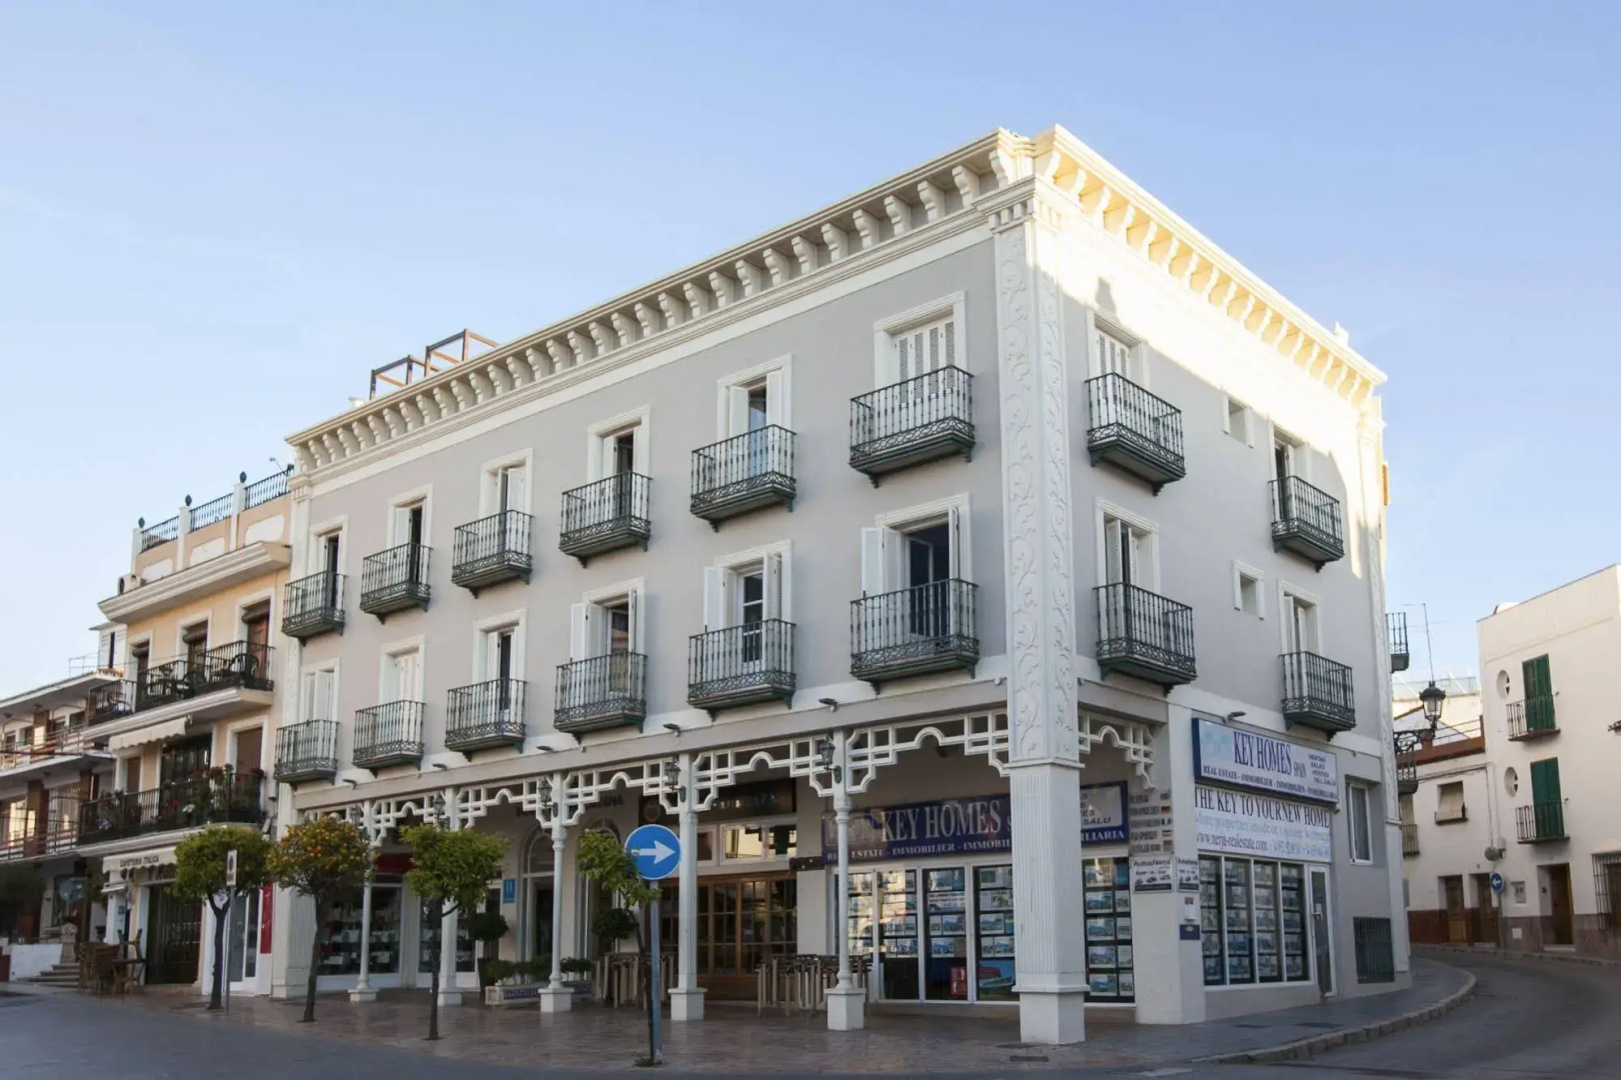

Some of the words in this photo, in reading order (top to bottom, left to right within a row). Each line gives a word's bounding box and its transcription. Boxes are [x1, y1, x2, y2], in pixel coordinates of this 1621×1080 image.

[1233, 731, 1254, 767] KEY
[1256, 736, 1291, 776] HOMES
[1203, 765, 1217, 777] REAL
[1218, 769, 1237, 780] ESTATE
[881, 808, 919, 842] KEY
[925, 799, 1001, 839] HOMES
[1083, 816, 1112, 825] SALU
[1195, 786, 1214, 811] THE
[1217, 790, 1237, 814] KEY
[1241, 795, 1254, 817] TO
[1255, 797, 1282, 821] YOUR
[1281, 801, 1301, 824] NEW
[1304, 806, 1329, 828] HOME
[852, 849, 885, 859] ESTATE
[891, 843, 955, 856] IMMOBILIER
[963, 838, 1012, 850] IMMOBIL
[1081, 830, 1125, 841] ILIARIA
